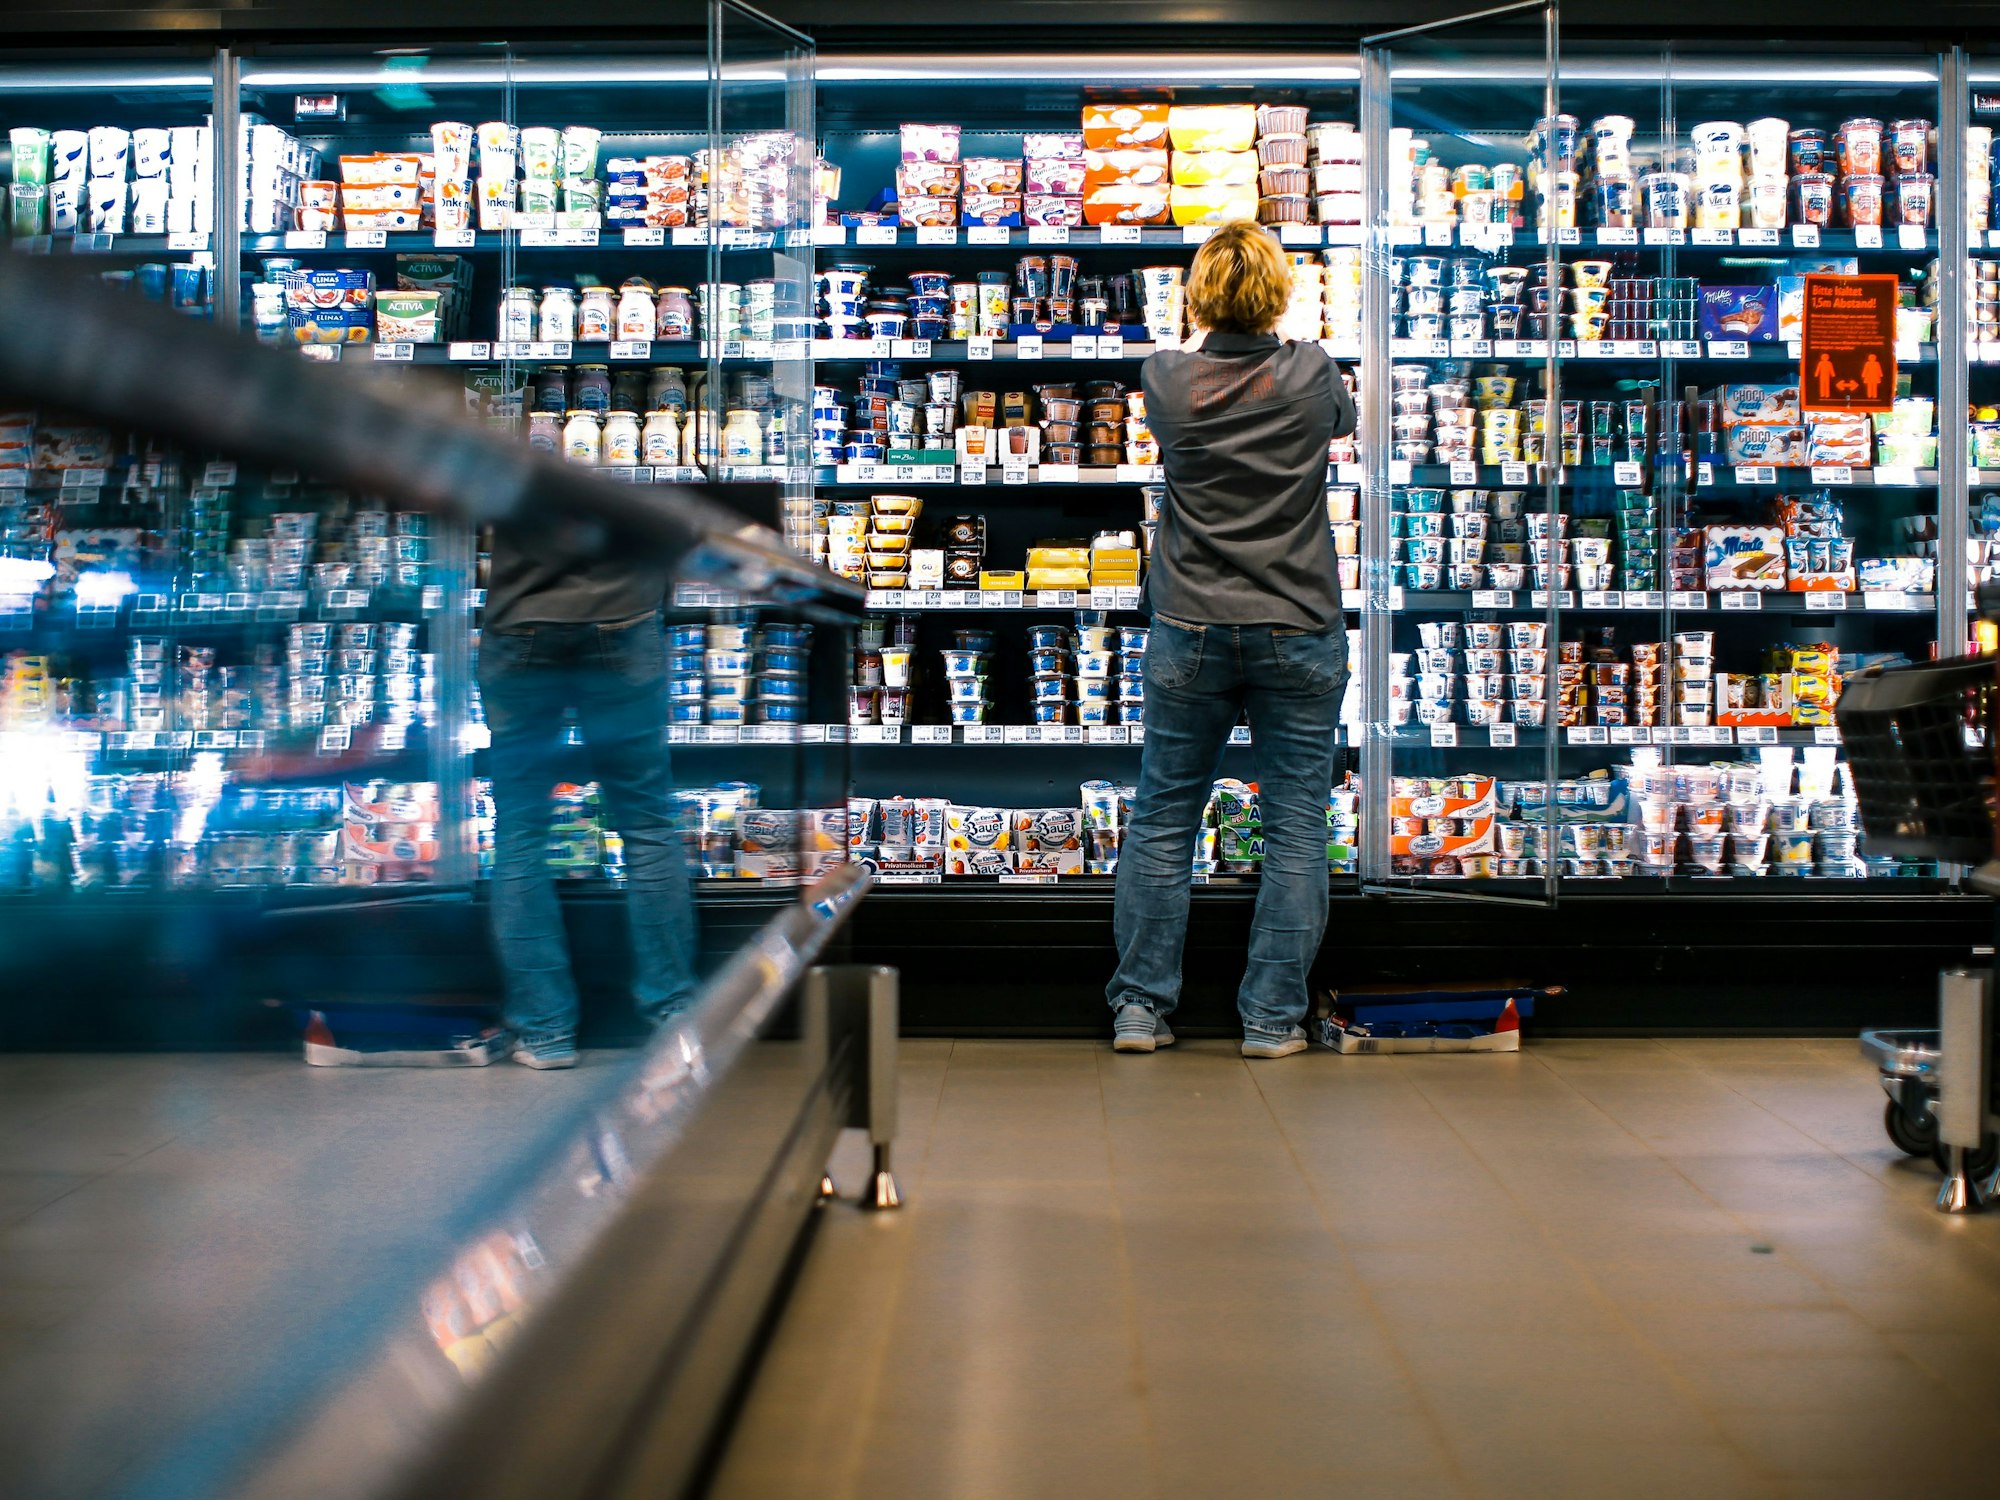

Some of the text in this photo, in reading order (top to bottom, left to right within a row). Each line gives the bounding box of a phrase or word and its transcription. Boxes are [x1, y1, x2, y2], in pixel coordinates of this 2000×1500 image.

[408, 264, 443, 274] ACTIVIA
[312, 276, 340, 284] ELINAS
[1812, 284, 1833, 296] Bitte
[1704, 290, 1732, 304] Milka
[1833, 298, 1877, 308] Abstand!
[388, 302, 424, 311] ACTIVIA
[1732, 390, 1765, 402] CHOCO
[1737, 400, 1762, 412] fresh
[1738, 430, 1770, 442] CHOCO
[1742, 441, 1767, 452] fresh
[1723, 536, 1764, 556] Monte
[1466, 801, 1490, 816] Classic
[964, 821, 1004, 836] Bauer
[1036, 822, 1076, 836] Bauer
[1466, 839, 1488, 854] Classic
